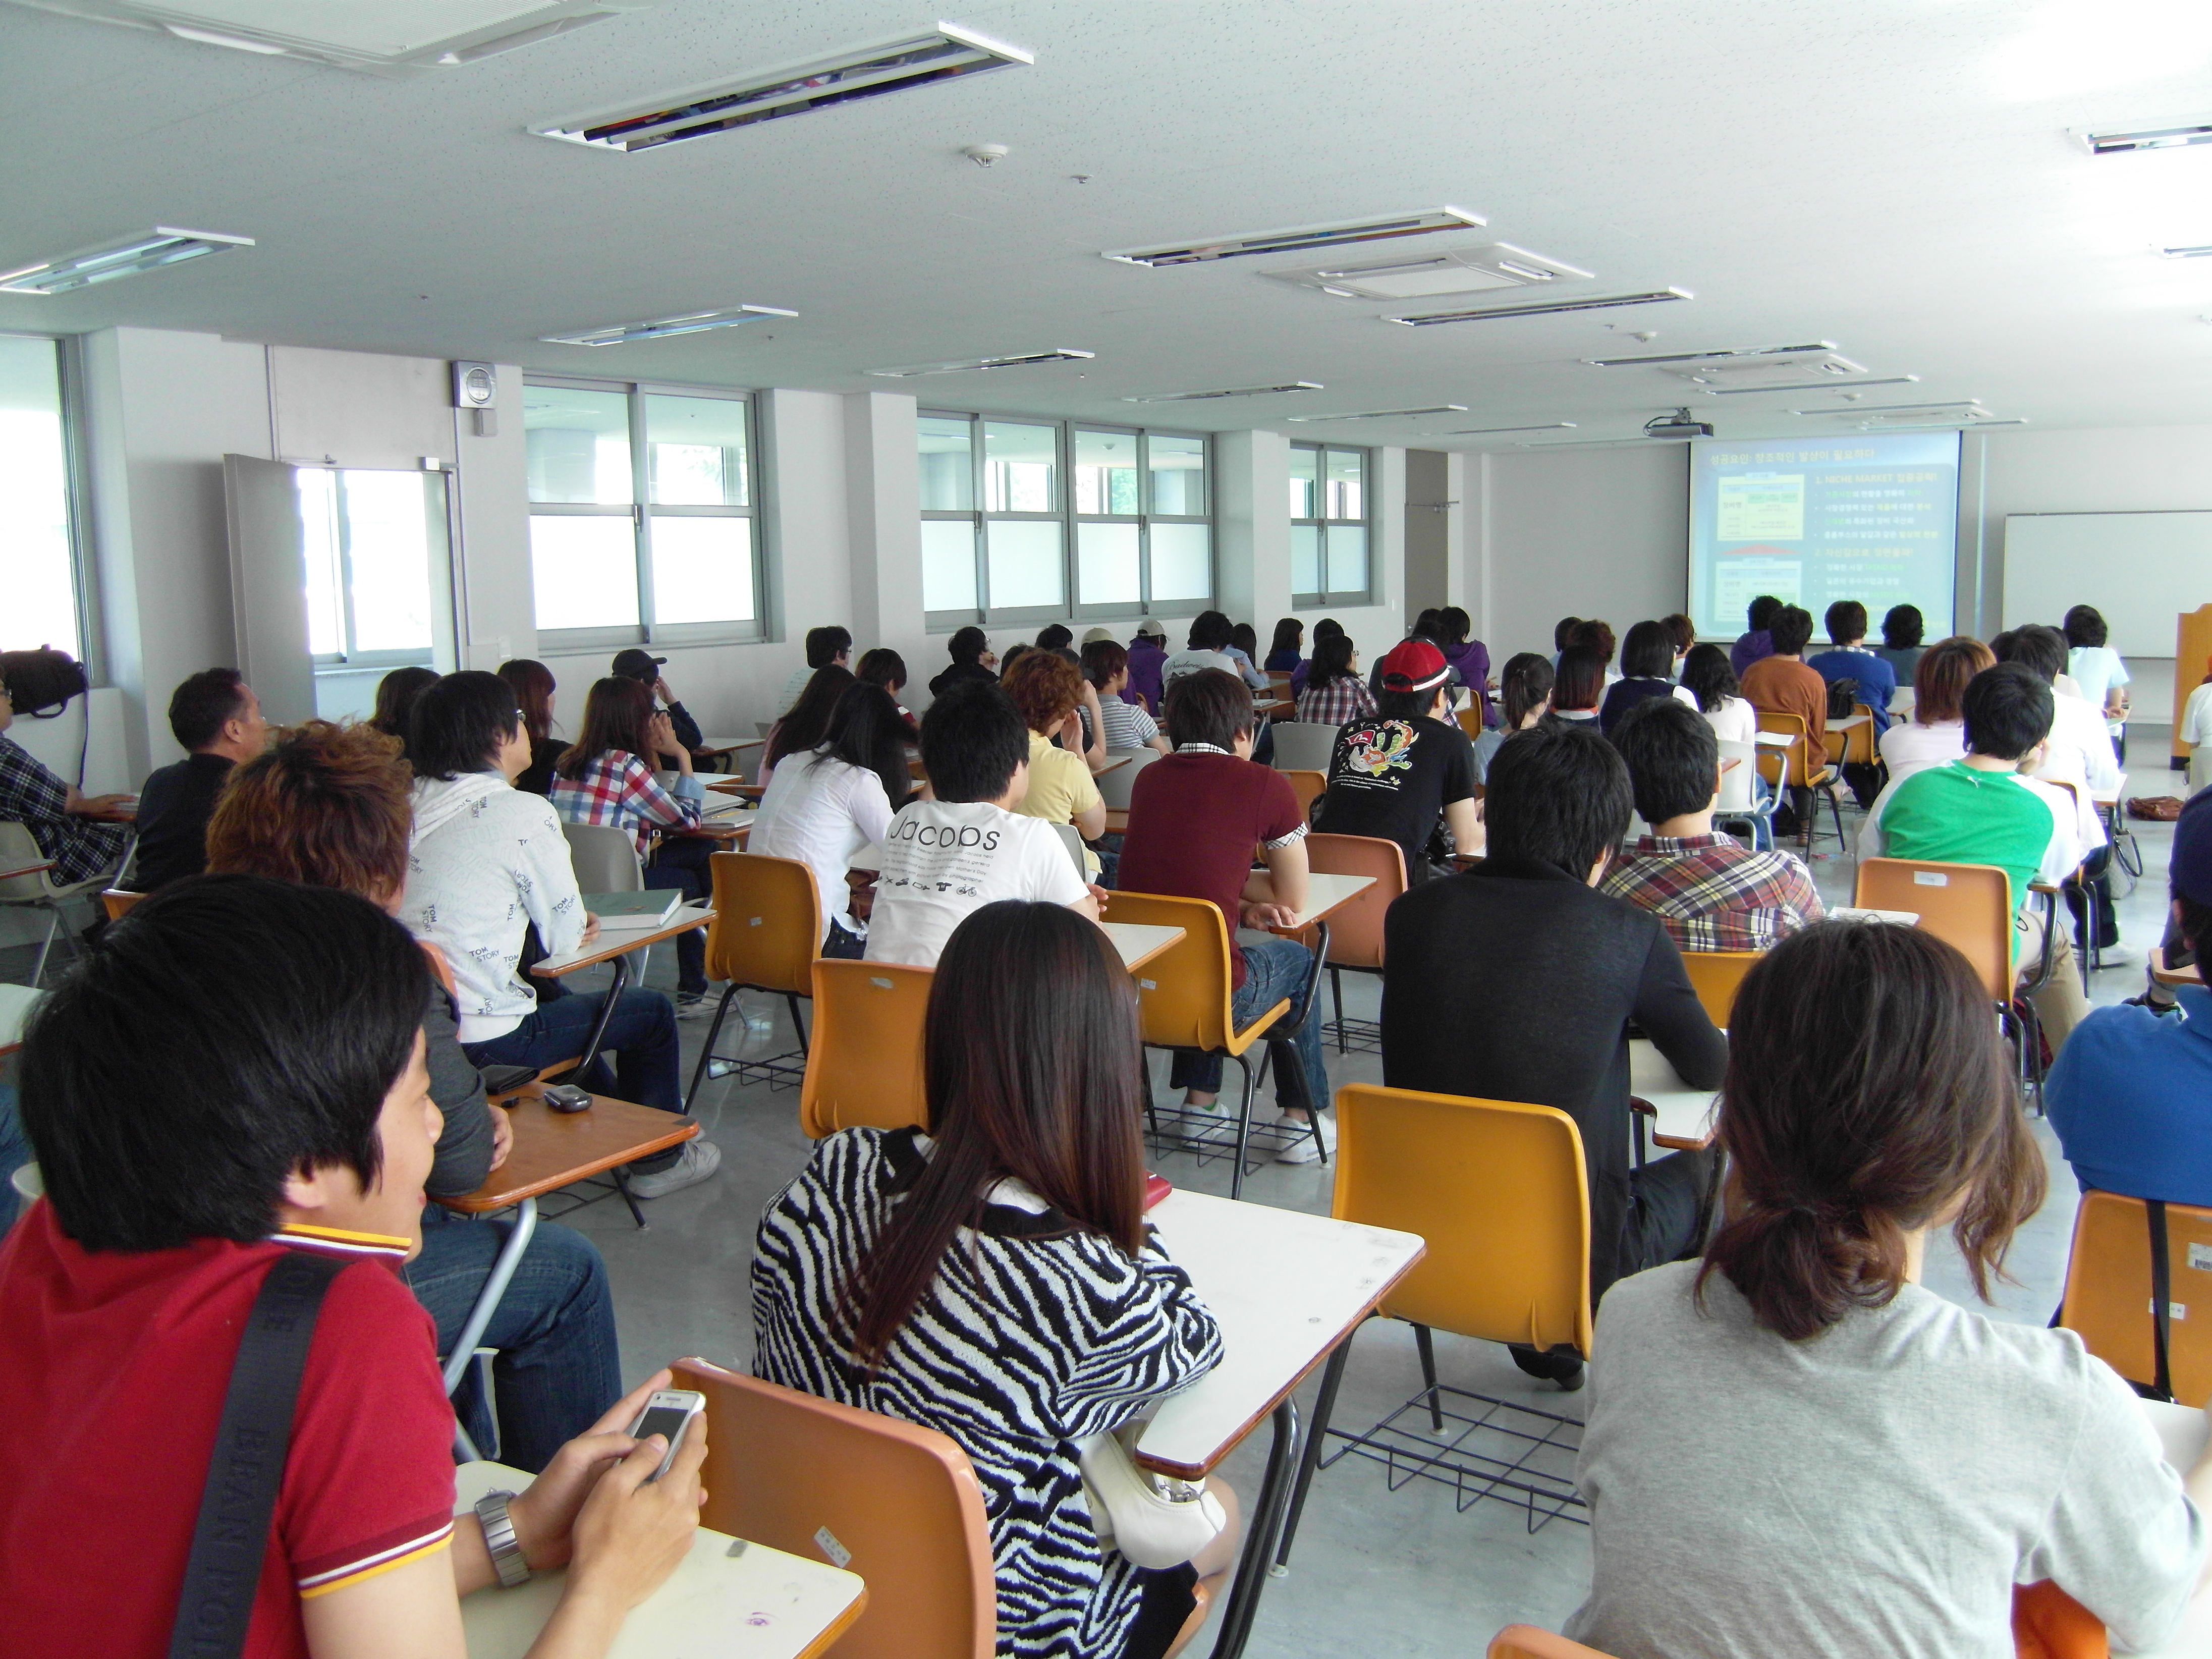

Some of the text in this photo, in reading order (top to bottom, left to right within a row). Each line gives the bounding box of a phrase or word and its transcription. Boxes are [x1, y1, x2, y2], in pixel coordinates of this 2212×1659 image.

[1710, 449, 1875, 465] 성공요인: 창조적인 발상이 필요하다
[1856, 474, 1892, 482] MARKET
[1166, 659, 1204, 671] Budweis
[471, 800, 480, 818] TORY
[544, 819, 558, 832] ORY
[890, 815, 1000, 851] Jacobs
[949, 874, 983, 882] photographer
[552, 897, 569, 913] TOM
[561, 893, 576, 915] STORY
[428, 904, 437, 923] TOM
[507, 904, 515, 921] TOM
[422, 910, 433, 933] STORY
[469, 946, 488, 957] TOM
[476, 949, 500, 962] STORY
[504, 954, 519, 962] TOM
[483, 997, 493, 1015] TORY
[190, 1566, 240, 1659] POL
